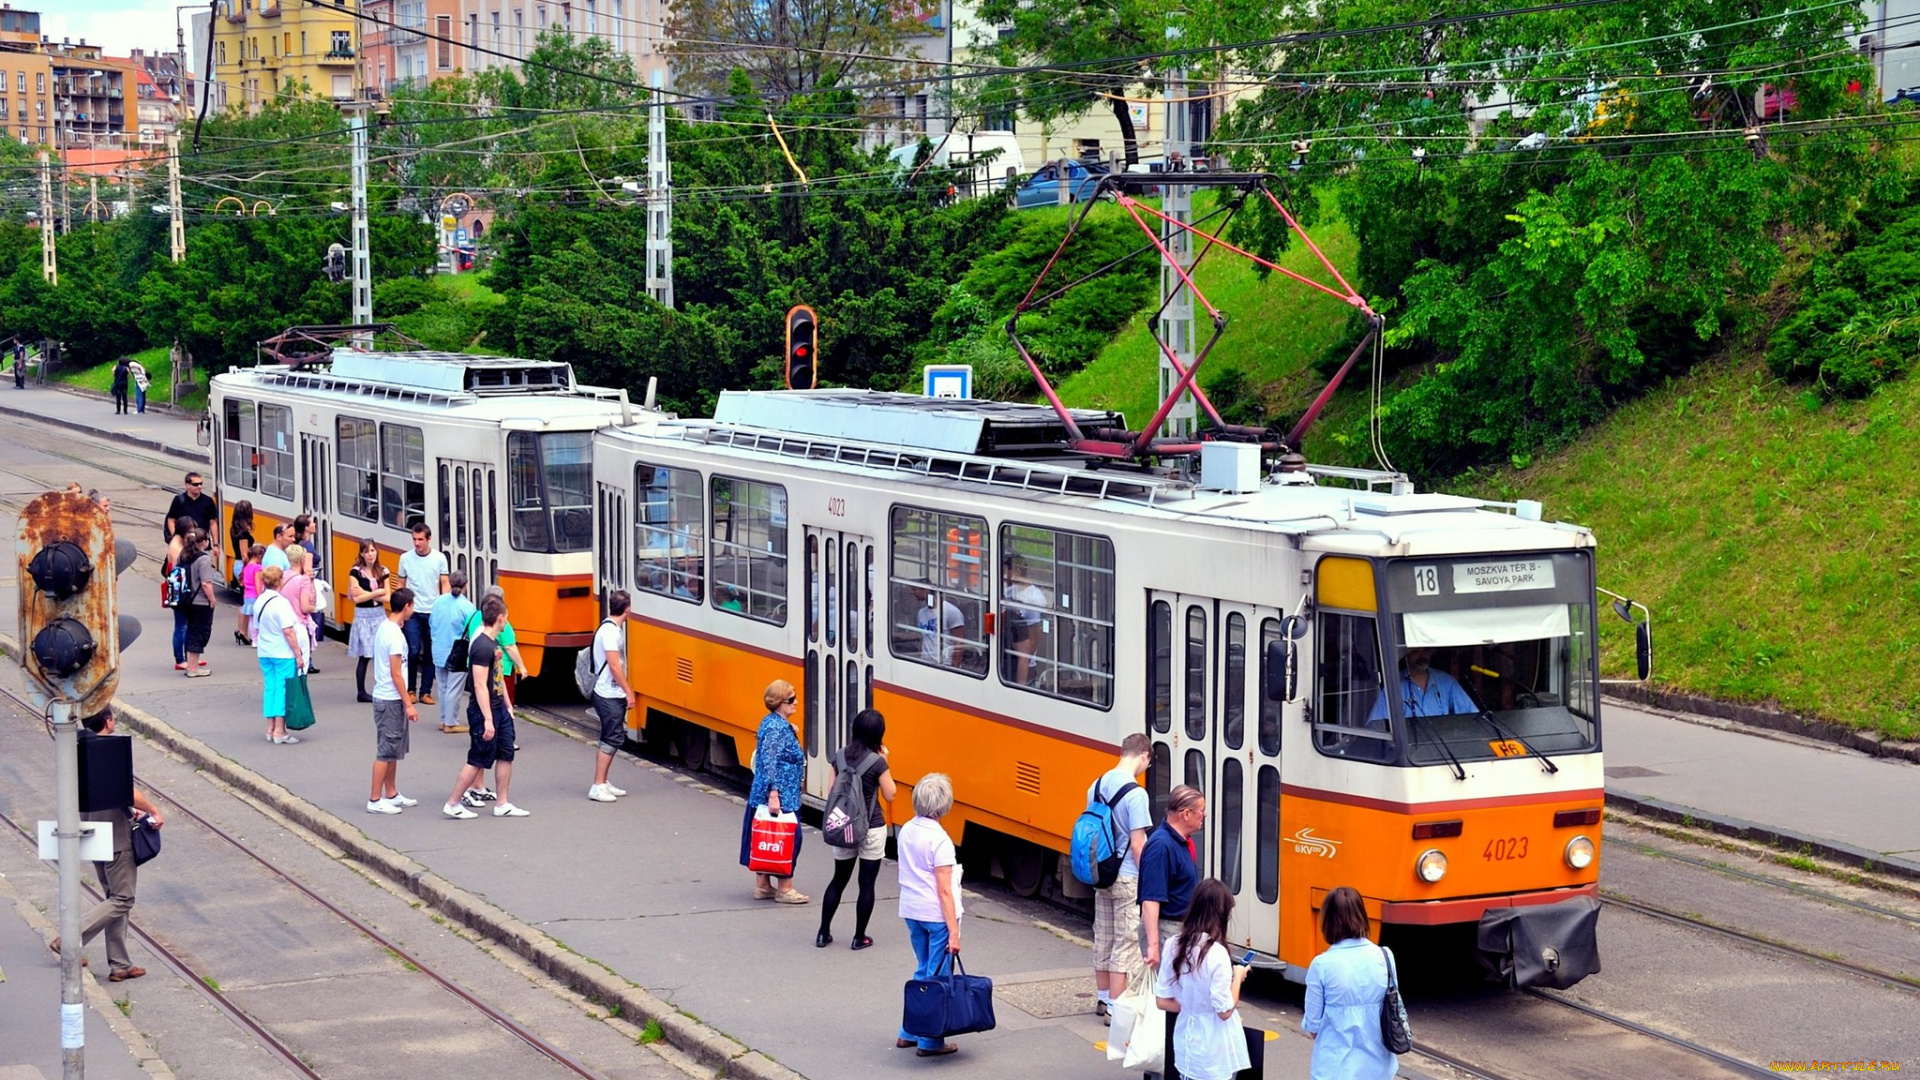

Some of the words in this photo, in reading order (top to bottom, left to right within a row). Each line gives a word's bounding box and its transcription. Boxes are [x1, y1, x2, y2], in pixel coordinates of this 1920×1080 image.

[828, 497, 845, 517] 4023
[1467, 565, 1508, 576] MOSZKVA
[1510, 562, 1527, 573] TÉR
[1416, 568, 1436, 592] 18
[1475, 575, 1510, 586] SAVOYA
[1512, 574, 1535, 583] PARK
[1483, 836, 1529, 862] 4023
